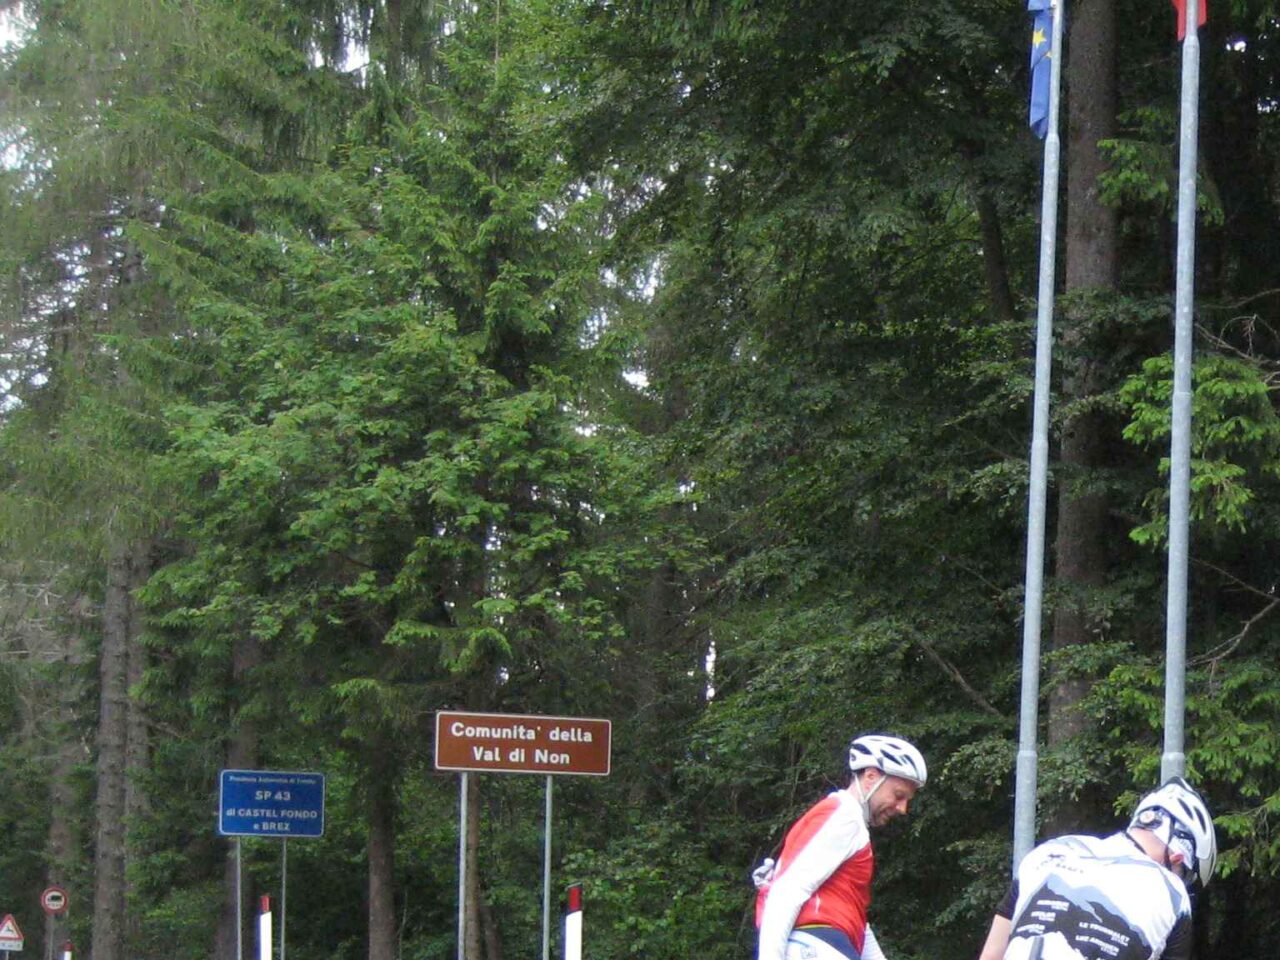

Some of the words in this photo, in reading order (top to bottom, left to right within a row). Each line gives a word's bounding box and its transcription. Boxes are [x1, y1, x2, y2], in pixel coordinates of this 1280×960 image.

[549, 726, 592, 742] della
[473, 746, 500, 762] Val
[509, 747, 525, 763] di
[535, 749, 570, 765] Non
[255, 790, 272, 801] SP
[274, 791, 291, 801] 43
[262, 822, 290, 831] BREZ
